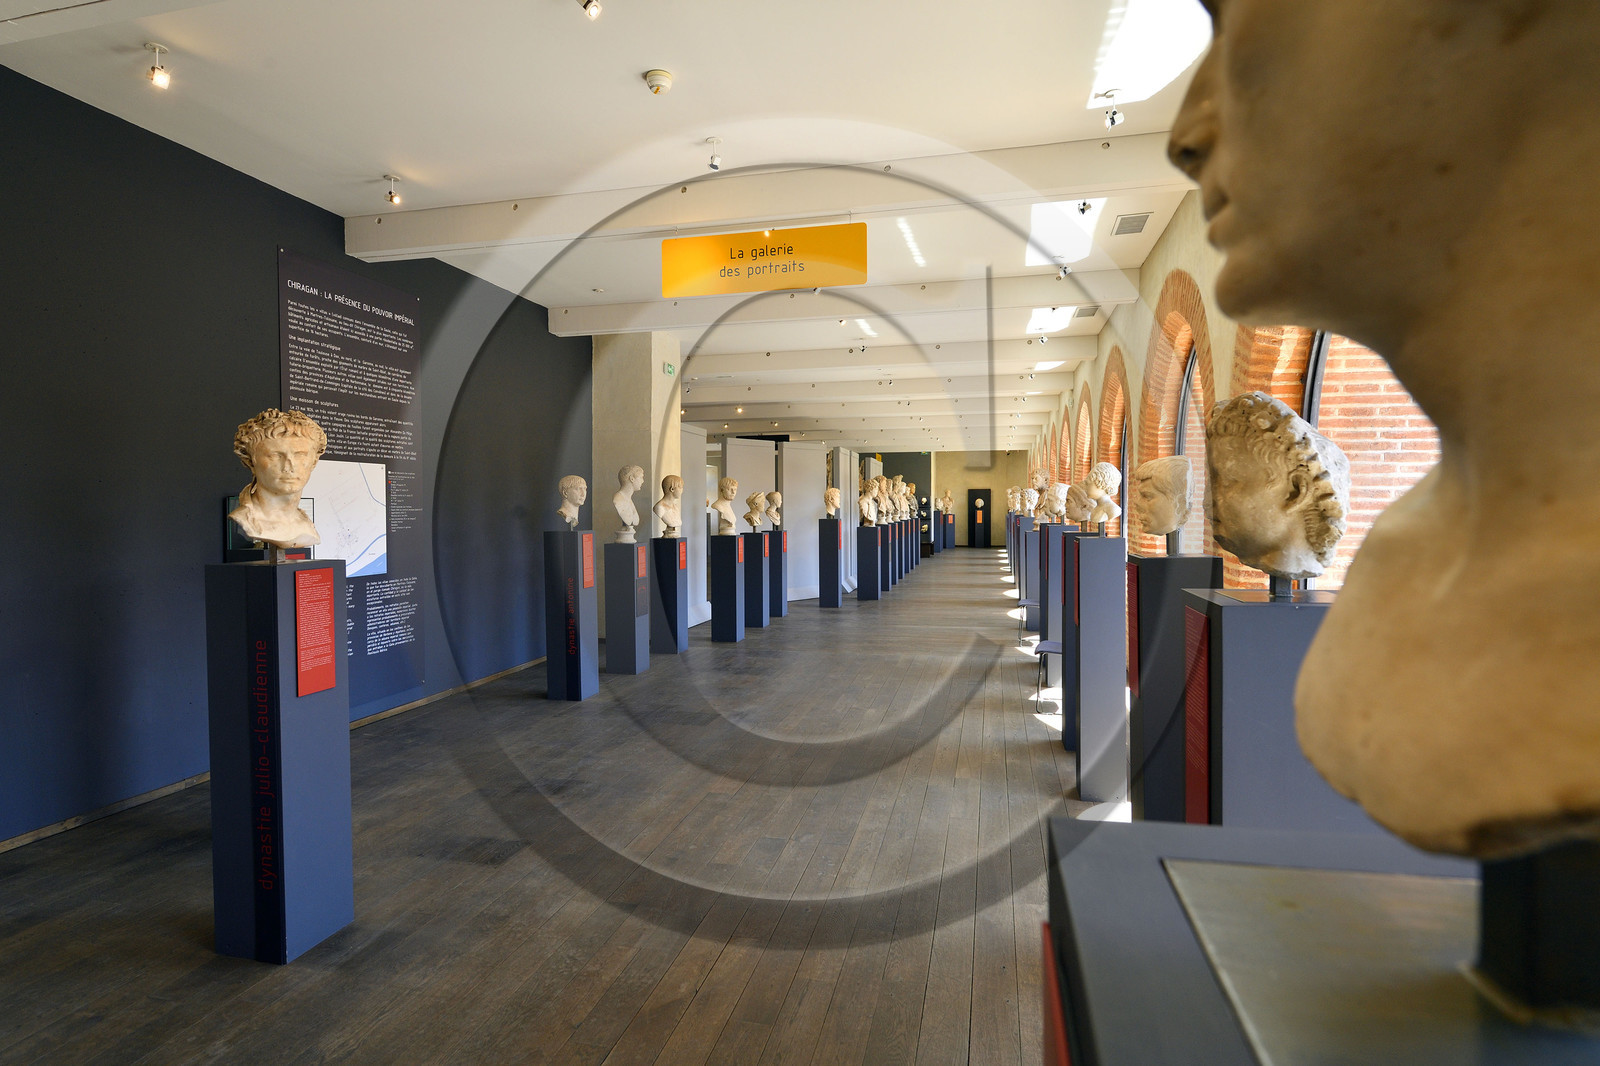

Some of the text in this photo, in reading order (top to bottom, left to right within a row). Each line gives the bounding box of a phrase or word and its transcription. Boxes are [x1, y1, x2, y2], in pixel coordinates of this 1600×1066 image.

[719, 260, 805, 278] des portraits
[729, 243, 794, 260] La galerie
[287, 279, 318, 296] CHIRAGAN
[324, 291, 332, 300] LA
[334, 294, 360, 309] PRÉSENCE
[362, 303, 370, 312] DU
[371, 306, 392, 320] POUVOIR
[394, 314, 414, 326] IMPÉRIAL
[568, 619, 577, 655] dynastie
[253, 640, 276, 890] dynastie julio-claudienne
